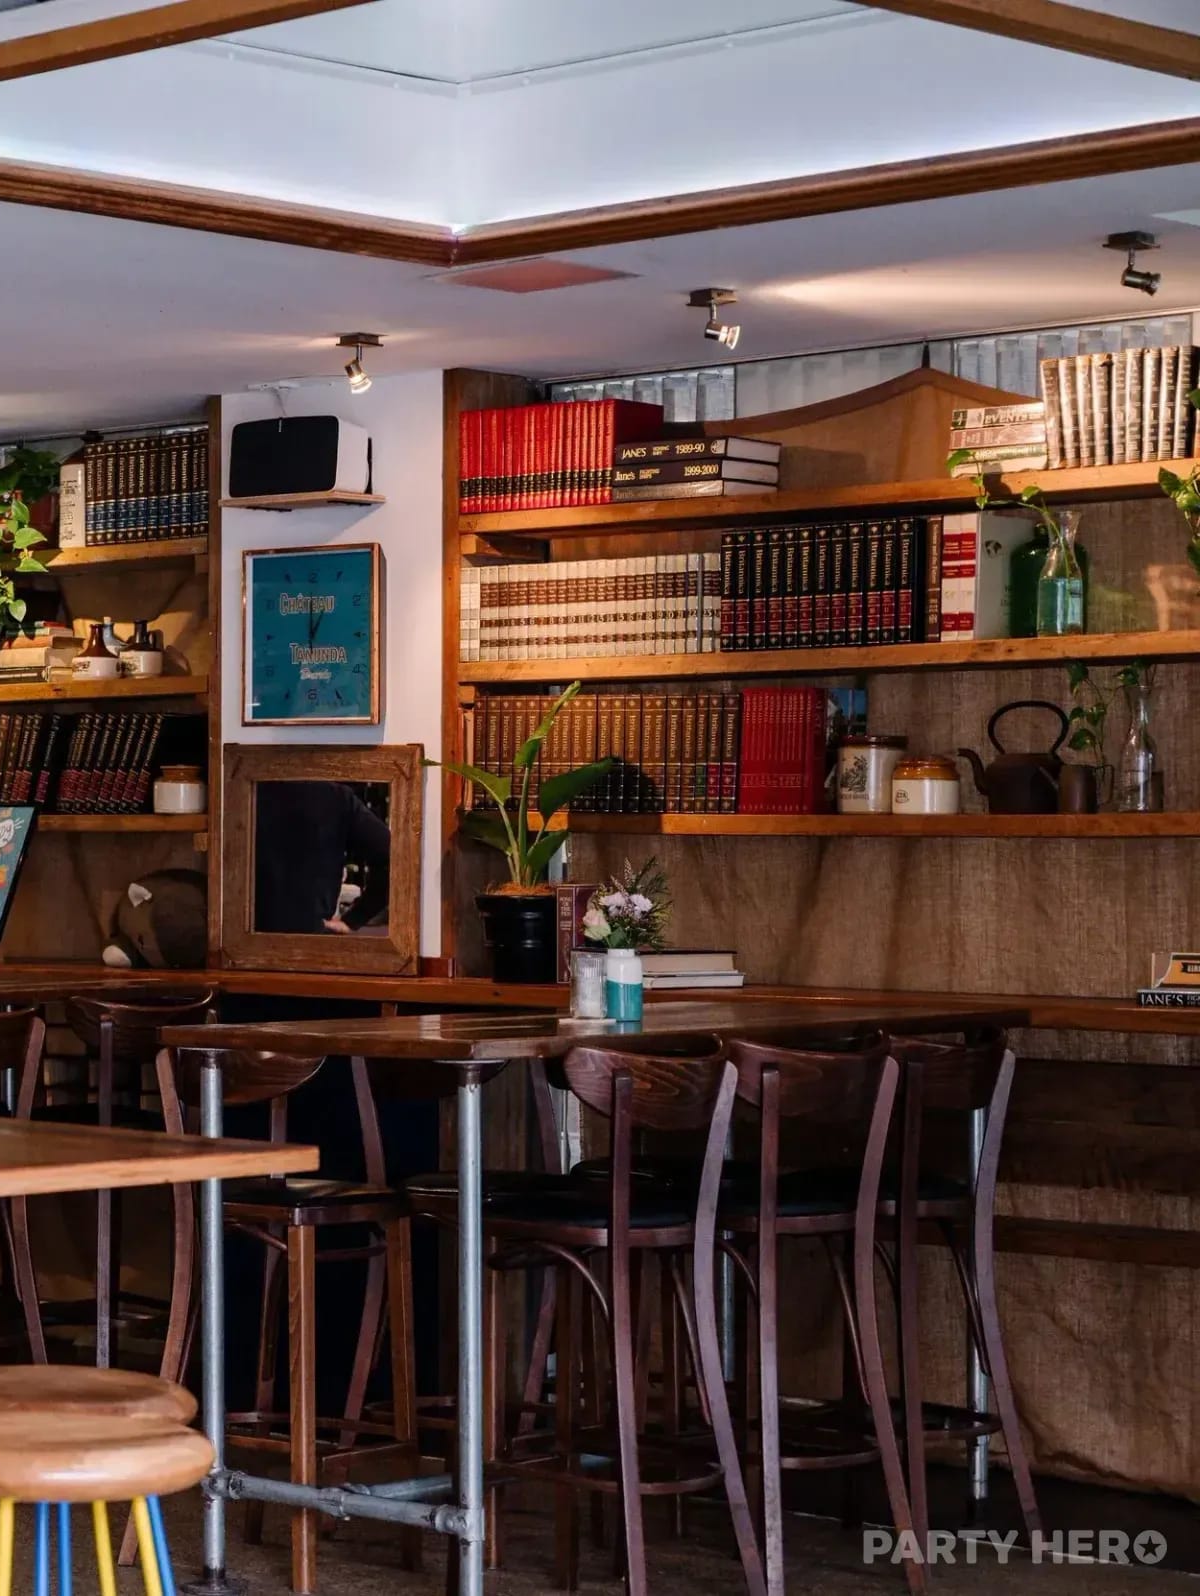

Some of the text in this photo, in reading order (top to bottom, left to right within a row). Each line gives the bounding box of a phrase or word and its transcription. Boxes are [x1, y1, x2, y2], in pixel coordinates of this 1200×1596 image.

[675, 443, 705, 454] 1989-90
[684, 464, 719, 476] 1999-2000
[724, 551, 732, 594] Britannica
[818, 545, 826, 590] Britannica
[870, 541, 878, 587] Britannica
[885, 540, 893, 585] Britannica
[901, 539, 910, 584] Britannica
[289, 642, 348, 665] TANUNDA
[726, 714, 734, 757] Britannica
[1141, 994, 1184, 1006] JANE'S
